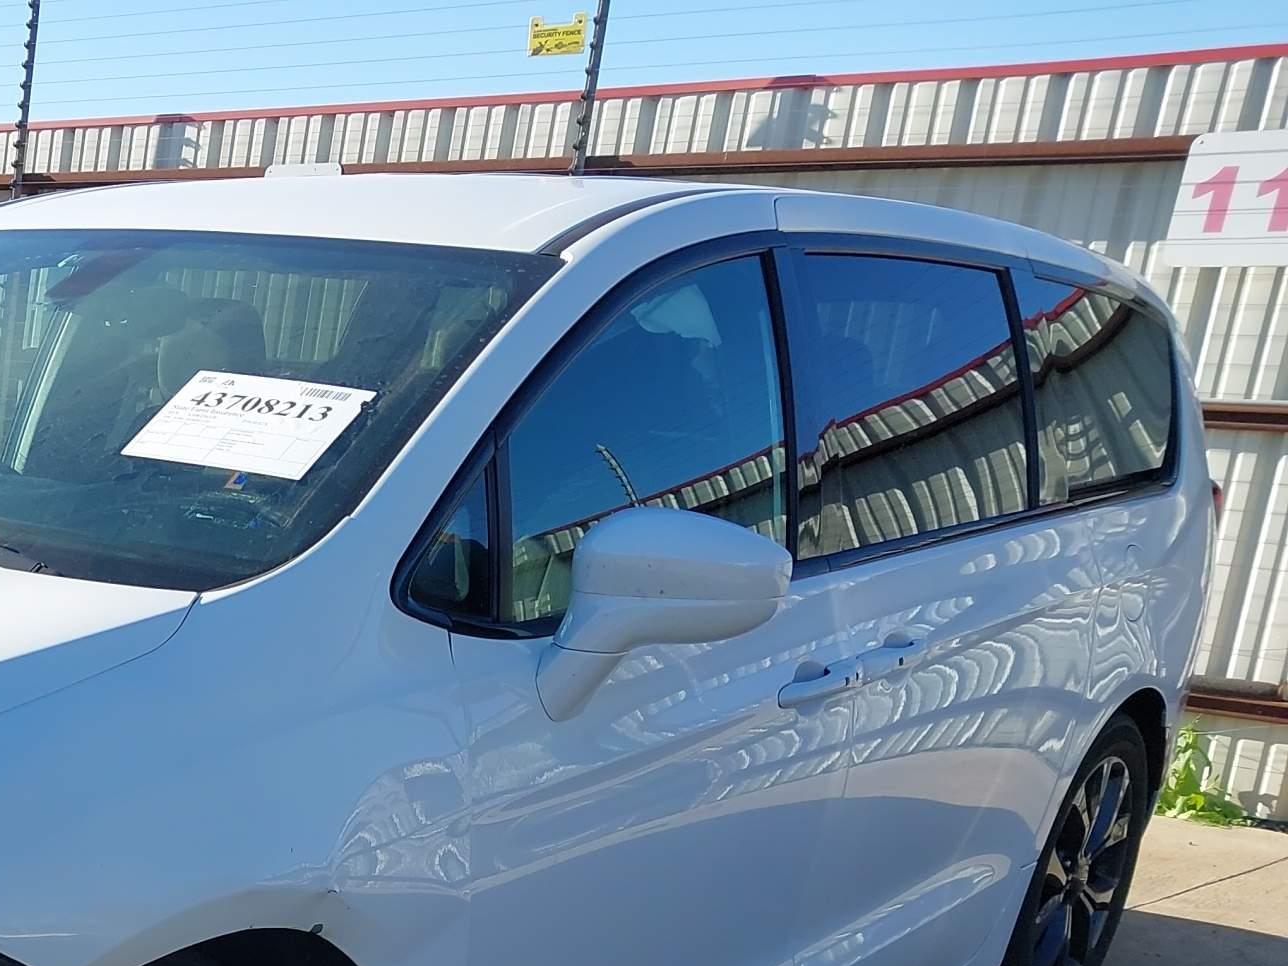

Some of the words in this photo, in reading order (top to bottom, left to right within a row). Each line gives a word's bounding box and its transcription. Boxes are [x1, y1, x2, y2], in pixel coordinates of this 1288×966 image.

[532, 31, 562, 39] SECURITY
[562, 29, 582, 37] FENCE
[1191, 165, 1288, 233] 11
[189, 389, 334, 422] 43708213
